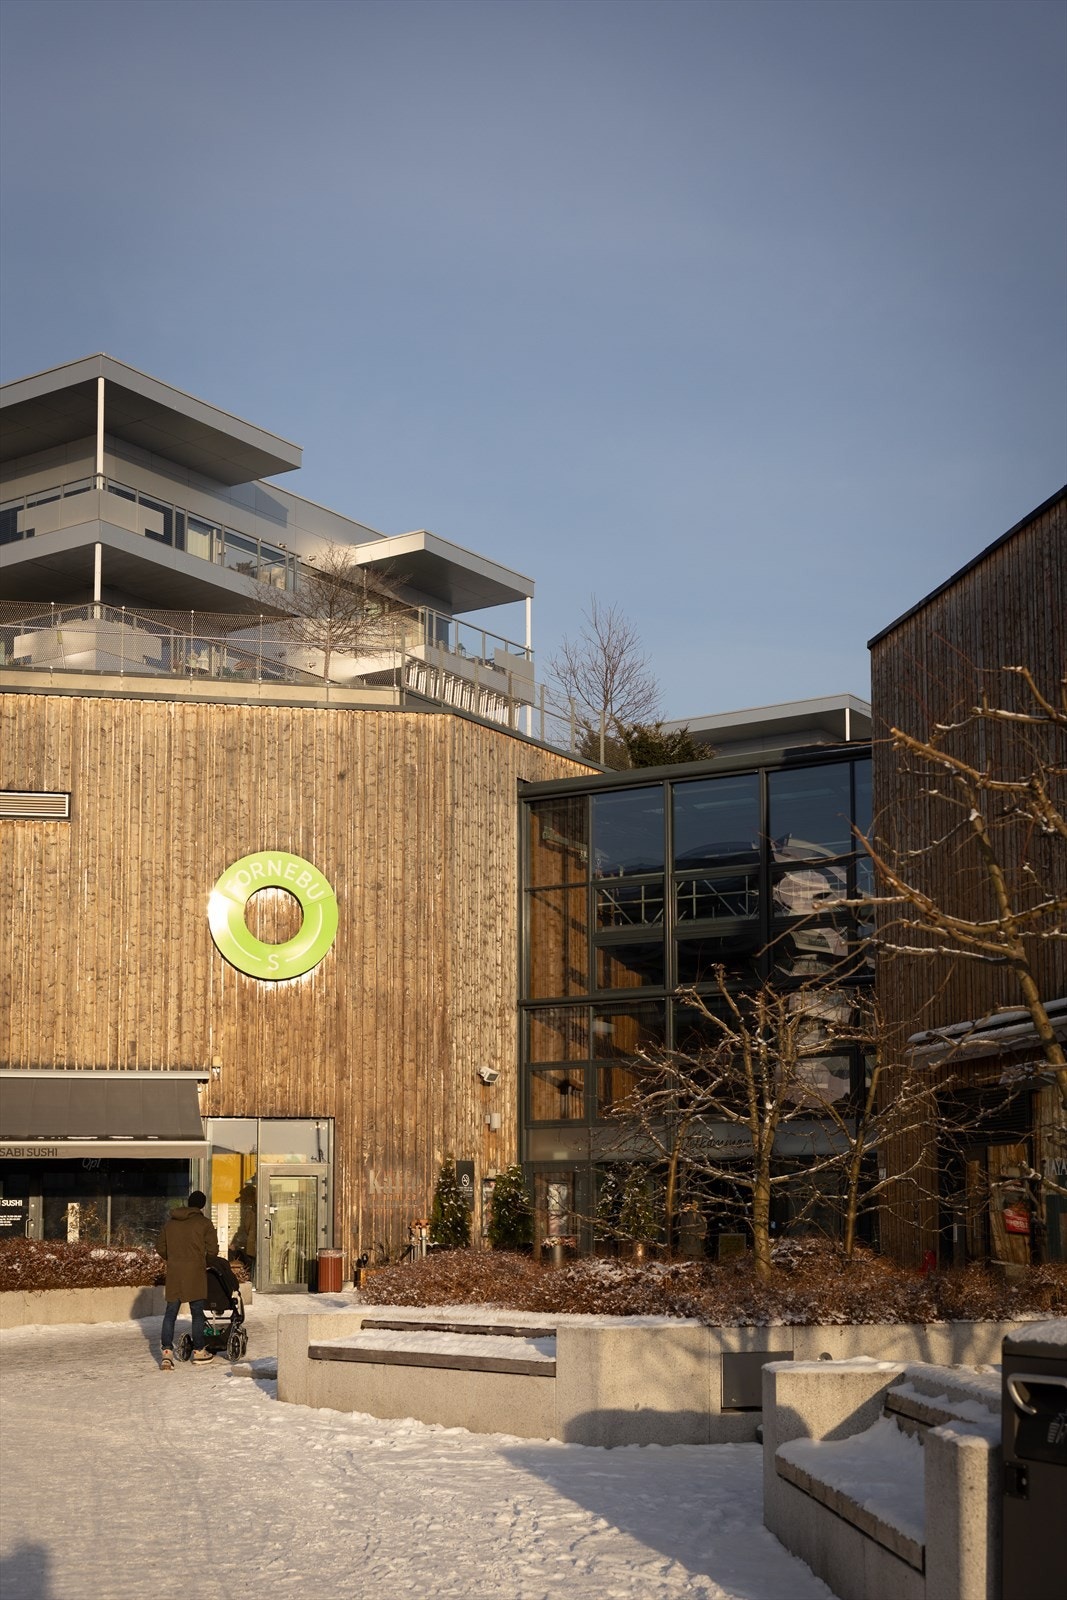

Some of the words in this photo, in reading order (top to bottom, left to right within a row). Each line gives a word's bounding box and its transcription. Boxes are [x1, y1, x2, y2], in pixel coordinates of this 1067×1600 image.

[224, 859, 325, 900] FORNEBU
[267, 953, 280, 971] S
[0, 1147, 25, 1157] SABI
[26, 1147, 58, 1157] SUSHI
[1, 1199, 23, 1207] SUSHI
